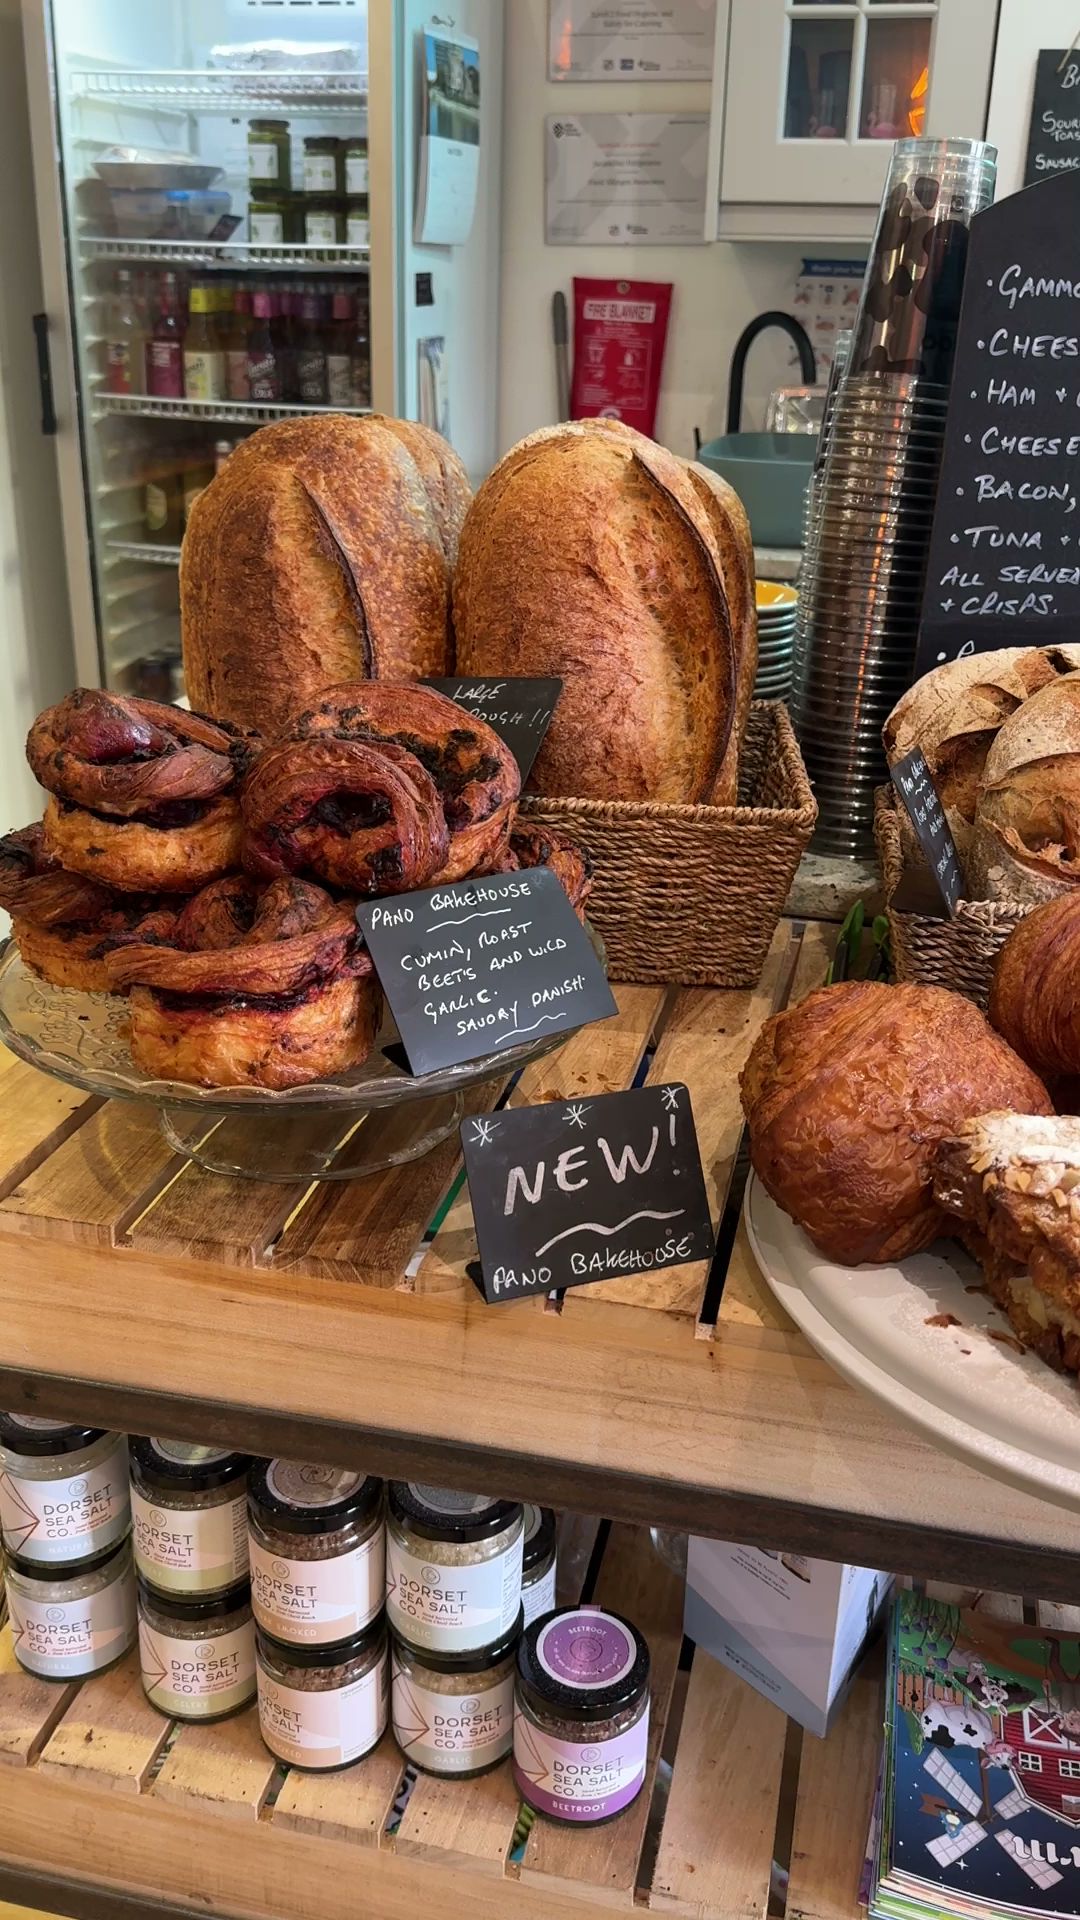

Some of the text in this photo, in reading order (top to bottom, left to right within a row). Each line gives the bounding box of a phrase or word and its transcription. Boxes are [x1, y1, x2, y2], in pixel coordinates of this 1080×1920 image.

[987, 378, 1036, 408] HAM
[980, 426, 1080, 457] CHEESE
[964, 525, 1042, 550] TUNA
[940, 566, 985, 587] ALL
[371, 883, 532, 930] PANO BAKEHOUSE
[400, 922, 532, 971] CUMIN, ROAST
[489, 950, 523, 971] AND
[528, 938, 567, 957] WILD
[503, 1113, 681, 1216] NEW!
[493, 1237, 692, 1294] PANO BAKEHOUSE
[43, 1483, 112, 1516] DORSET
[45, 1515, 75, 1527] SEA
[81, 1496, 113, 1520] SALT
[46, 1528, 73, 1538] CO.
[135, 1514, 193, 1545] DORSET
[136, 1527, 194, 1557] SEA SALT
[255, 1566, 317, 1597] DORSET
[399, 1573, 468, 1602] DORSET
[256, 1583, 318, 1608] SEA SALT
[399, 1587, 467, 1614] SEA SALT
[399, 1600, 420, 1619] CO.
[26, 1618, 92, 1635] DORSET
[28, 1630, 93, 1645] SEA SALT
[568, 1625, 607, 1636] BEETROOT
[29, 1642, 50, 1655] CO.
[171, 1651, 239, 1672] DORSET
[172, 1663, 240, 1683] SEA SALT
[172, 1683, 197, 1694] CO.
[271, 1713, 302, 1733] SALT
[434, 1704, 503, 1727] DORSET
[434, 1716, 502, 1738] SEA SALT
[434, 1738, 460, 1749] CO.
[553, 1755, 624, 1776] DORSET
[553, 1767, 624, 1786] SEA SALT
[552, 1784, 578, 1797] CO.
[552, 1800, 606, 1813] BEETROOT
